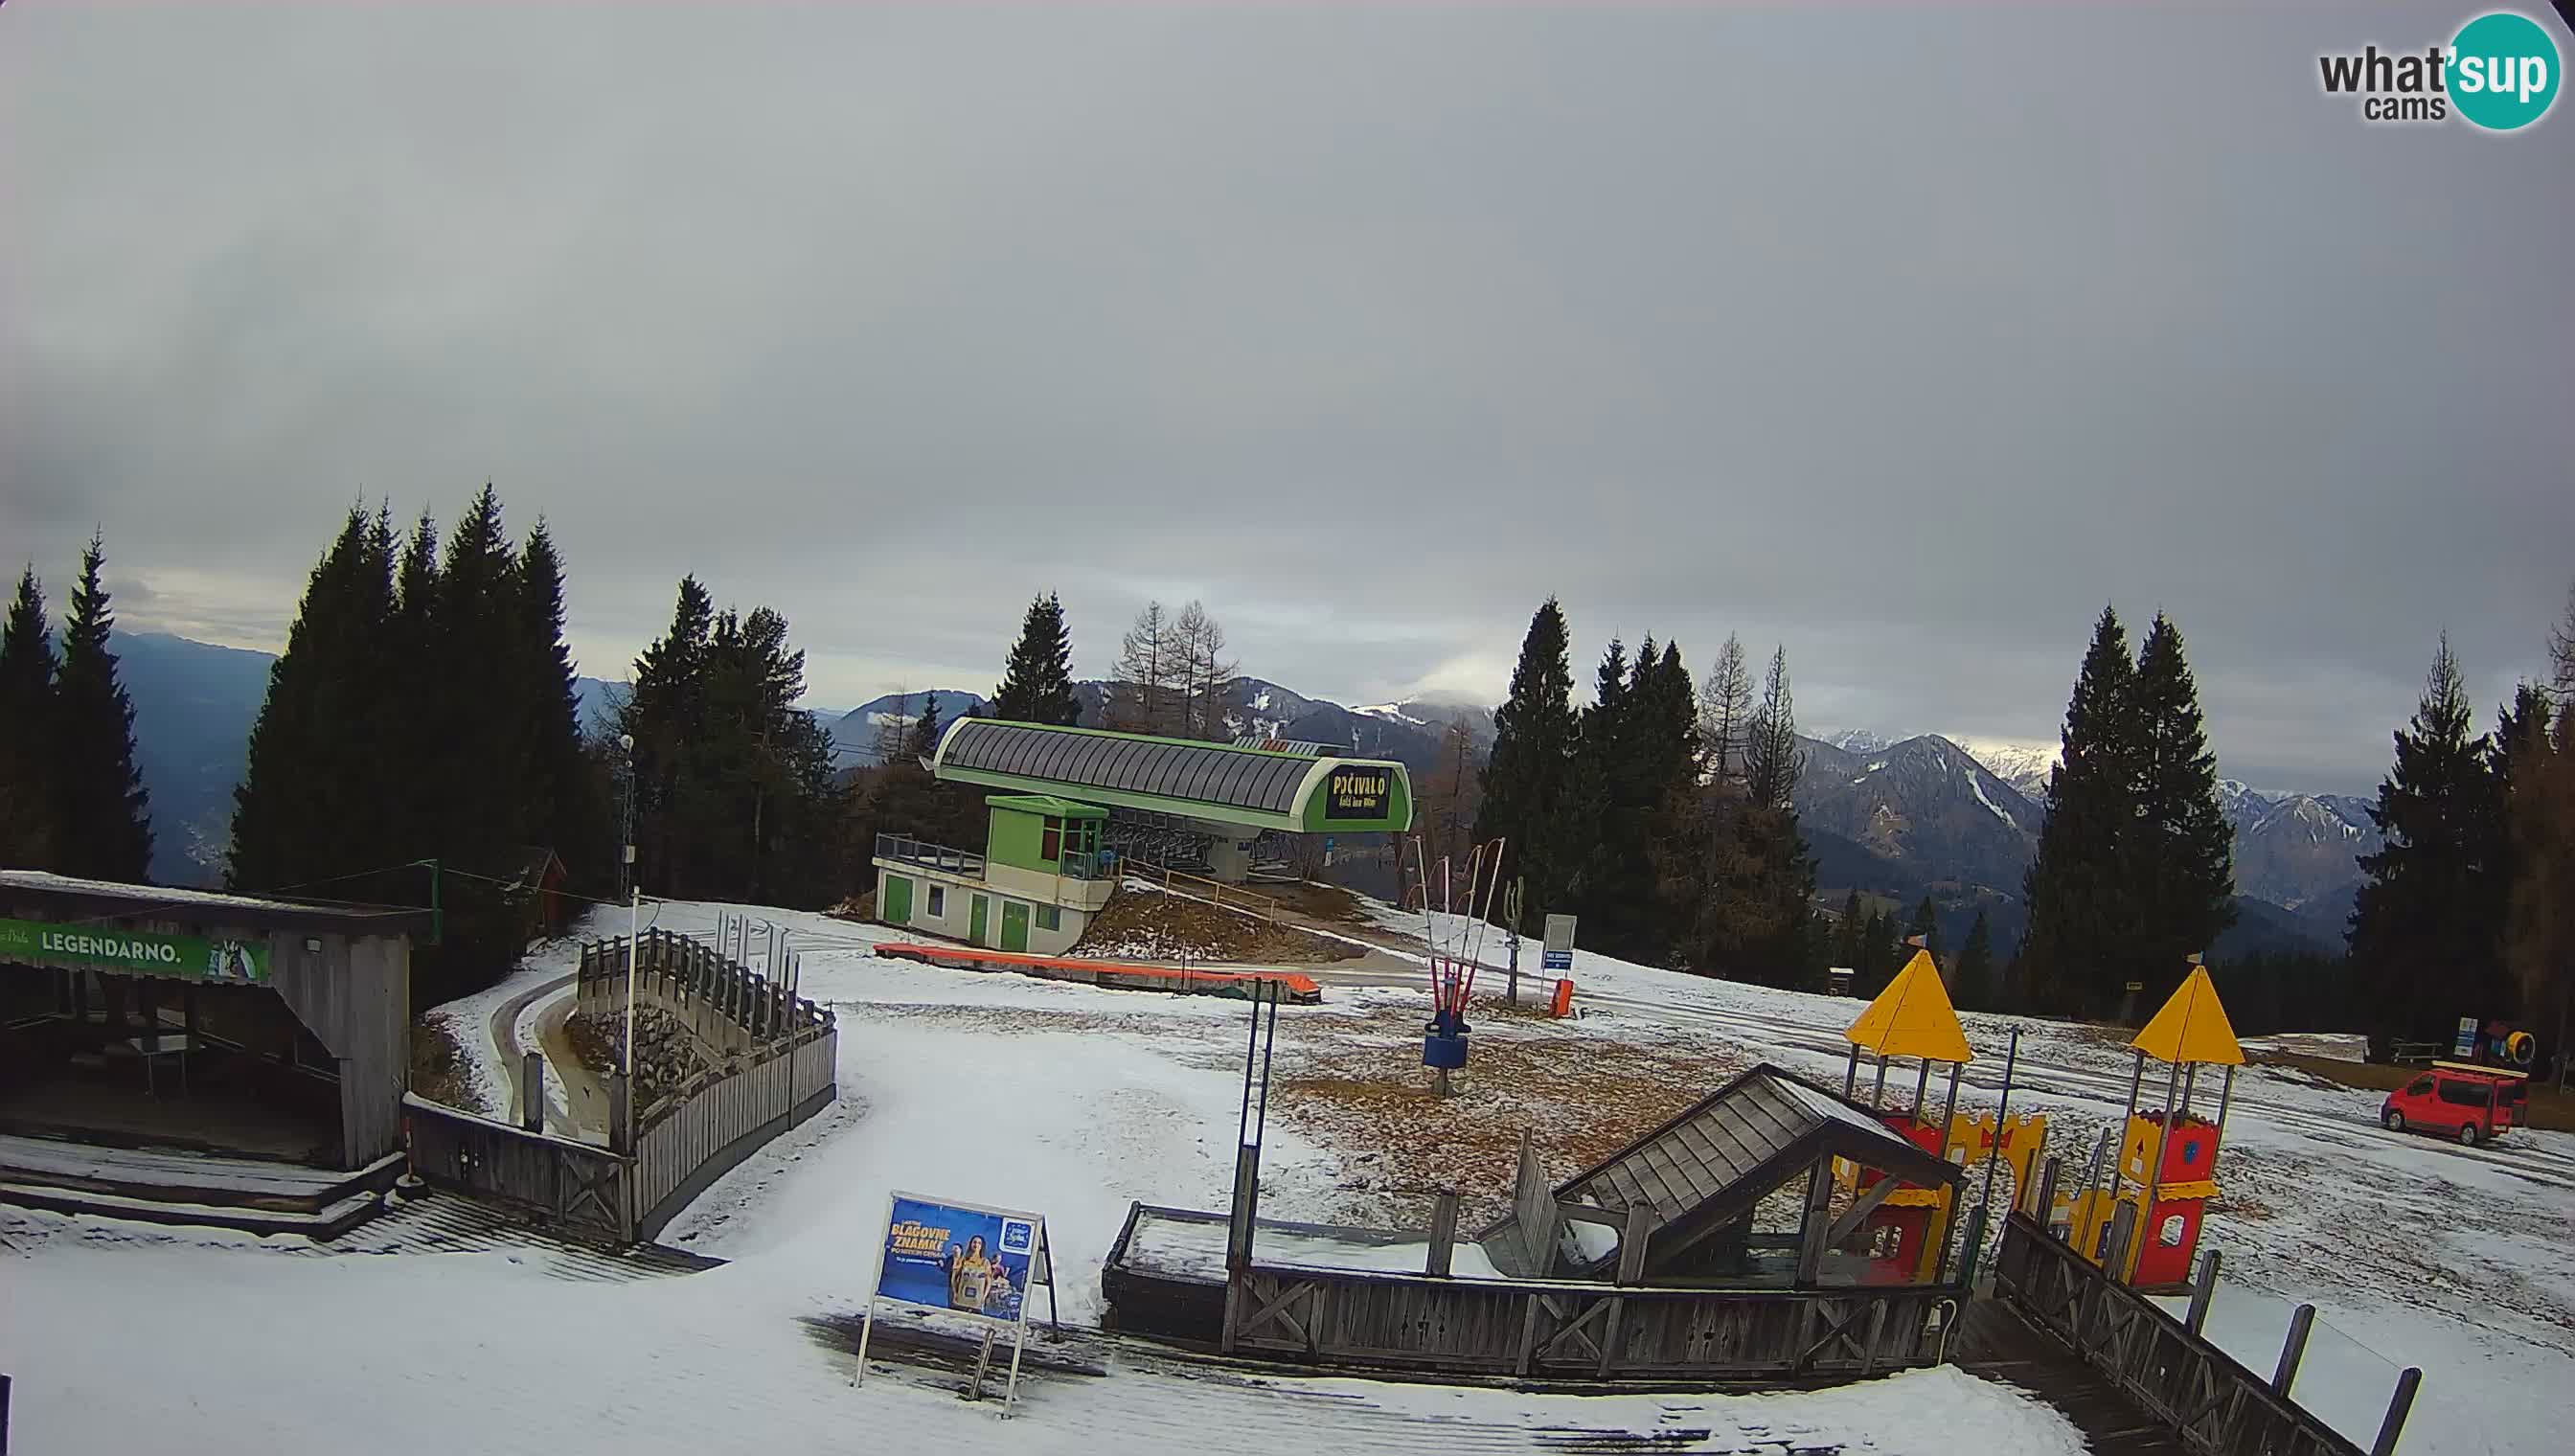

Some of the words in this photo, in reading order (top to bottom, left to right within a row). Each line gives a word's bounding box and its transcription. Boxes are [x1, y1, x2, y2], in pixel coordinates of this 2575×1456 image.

[42, 931, 182, 964] LEGENDARNO.
[891, 1223, 951, 1240] BLAGOVNE
[894, 1236, 944, 1251] ZNAMKE
